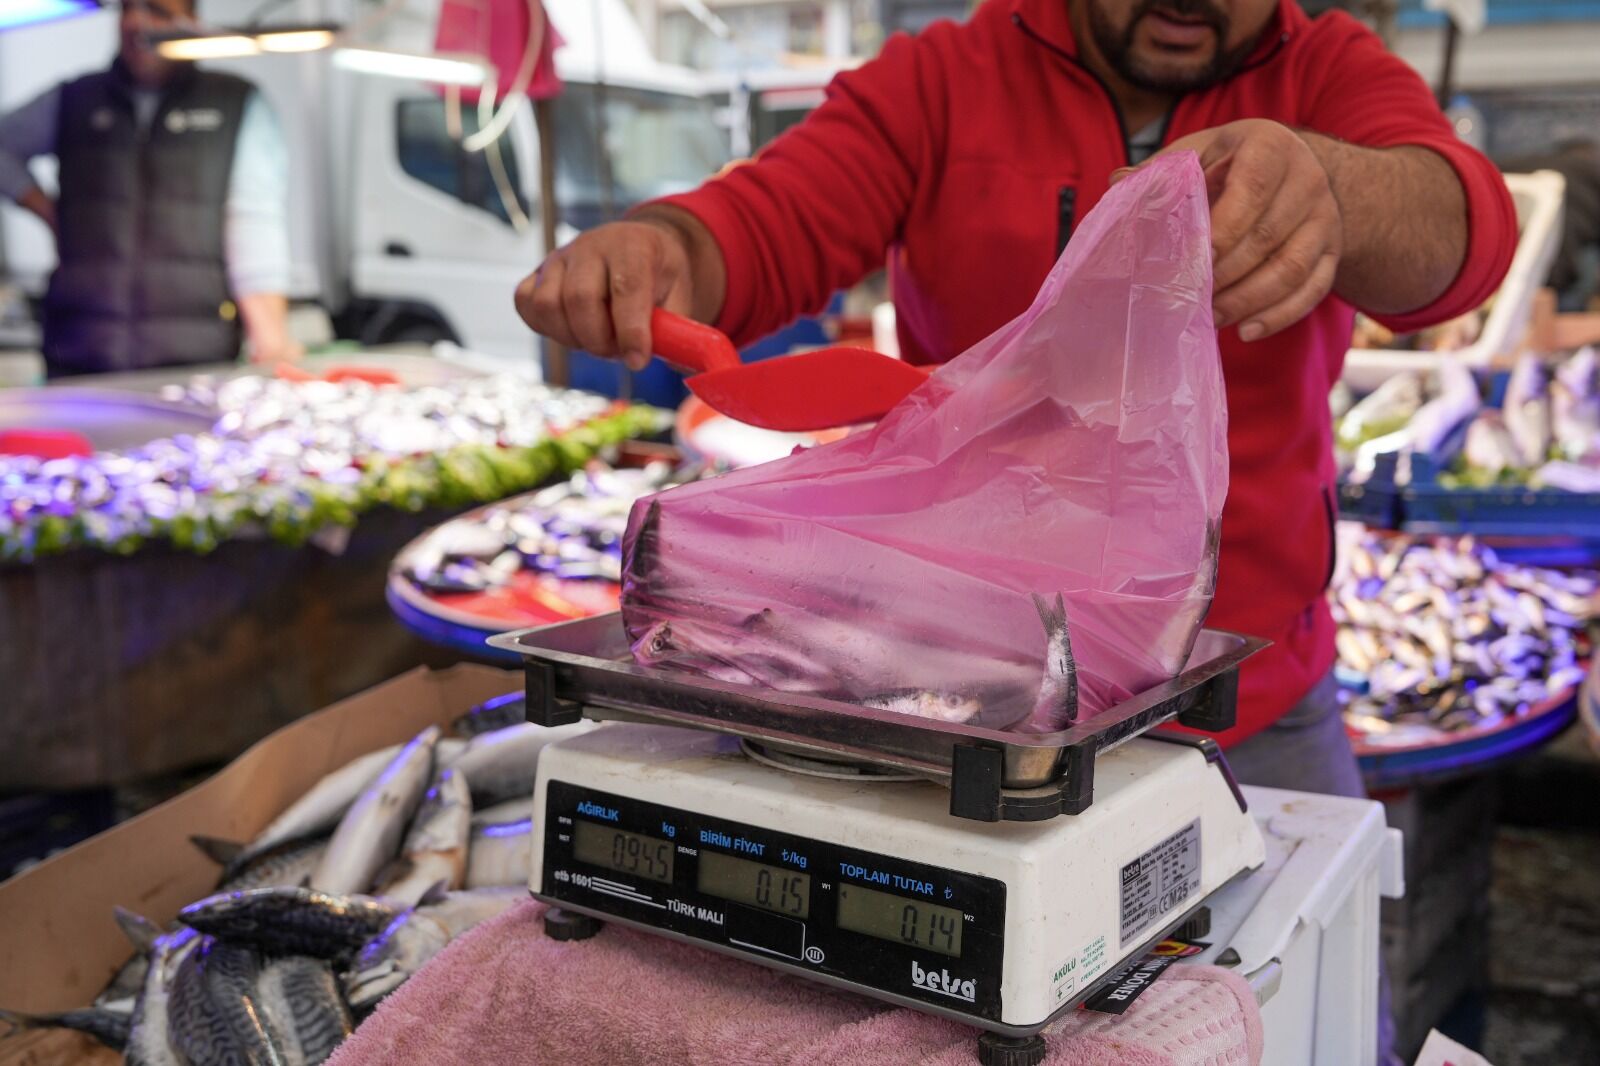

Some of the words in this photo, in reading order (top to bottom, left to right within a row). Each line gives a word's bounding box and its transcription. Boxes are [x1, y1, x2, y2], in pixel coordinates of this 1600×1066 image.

[577, 801, 619, 820] AĞIRLIK
[662, 821, 676, 837] kg
[700, 830, 731, 848] BİRİM
[734, 837, 765, 856] FİYAT
[554, 869, 570, 882] etb
[840, 862, 890, 886] TOPLAM
[893, 874, 934, 896] TUTAR
[667, 899, 696, 918] TÜRK
[697, 908, 724, 925] MALI
[963, 912, 976, 922] W2
[901, 904, 956, 950] 0.14
[1053, 957, 1076, 983] AKÜLÜ
[1107, 972, 1153, 1001] DÖNER
